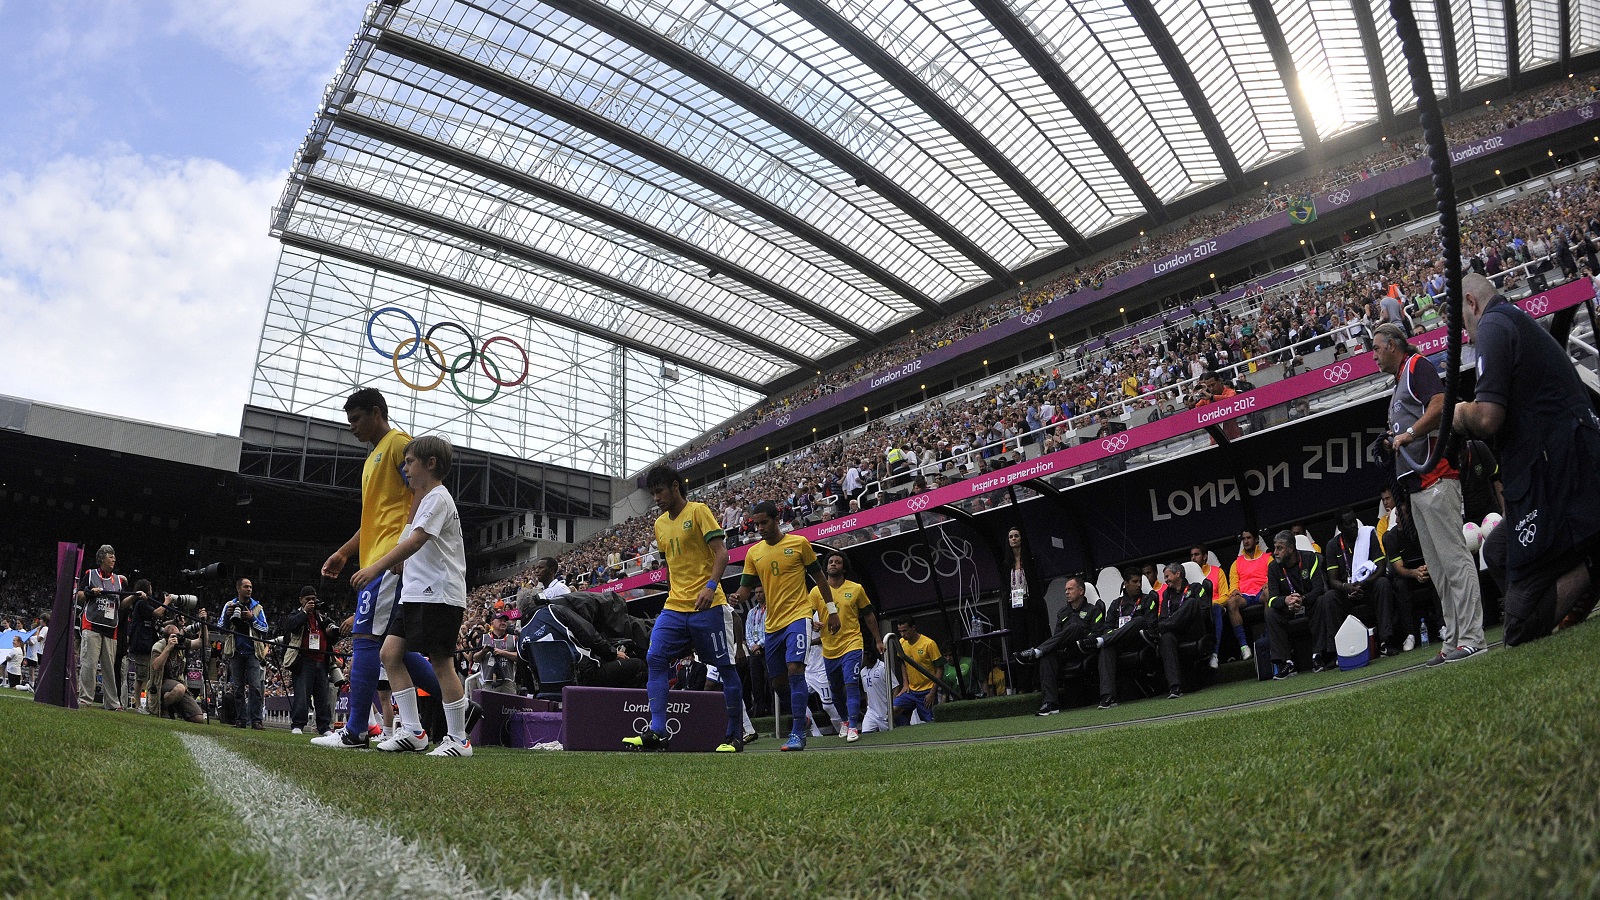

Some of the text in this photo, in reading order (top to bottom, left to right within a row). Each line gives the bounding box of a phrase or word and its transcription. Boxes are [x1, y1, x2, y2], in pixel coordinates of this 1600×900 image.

[1451, 136, 1504, 162] London 2012
[1153, 240, 1218, 274] London 2012
[870, 359, 922, 388] London 2012
[1197, 396, 1256, 423] London 2012
[676, 449, 710, 470] London 2012
[971, 461, 1054, 493] Inspire a generation
[1149, 427, 1386, 521] London 2012
[817, 518, 857, 536] London 2012
[669, 536, 682, 557] 11
[771, 560, 780, 577] 8
[359, 590, 372, 615] 3
[710, 630, 726, 652] 11
[796, 633, 806, 649] 8
[853, 662, 860, 675] 6
[820, 687, 830, 698] 11
[866, 677, 873, 687] 15
[623, 700, 691, 714] Lond 2012
